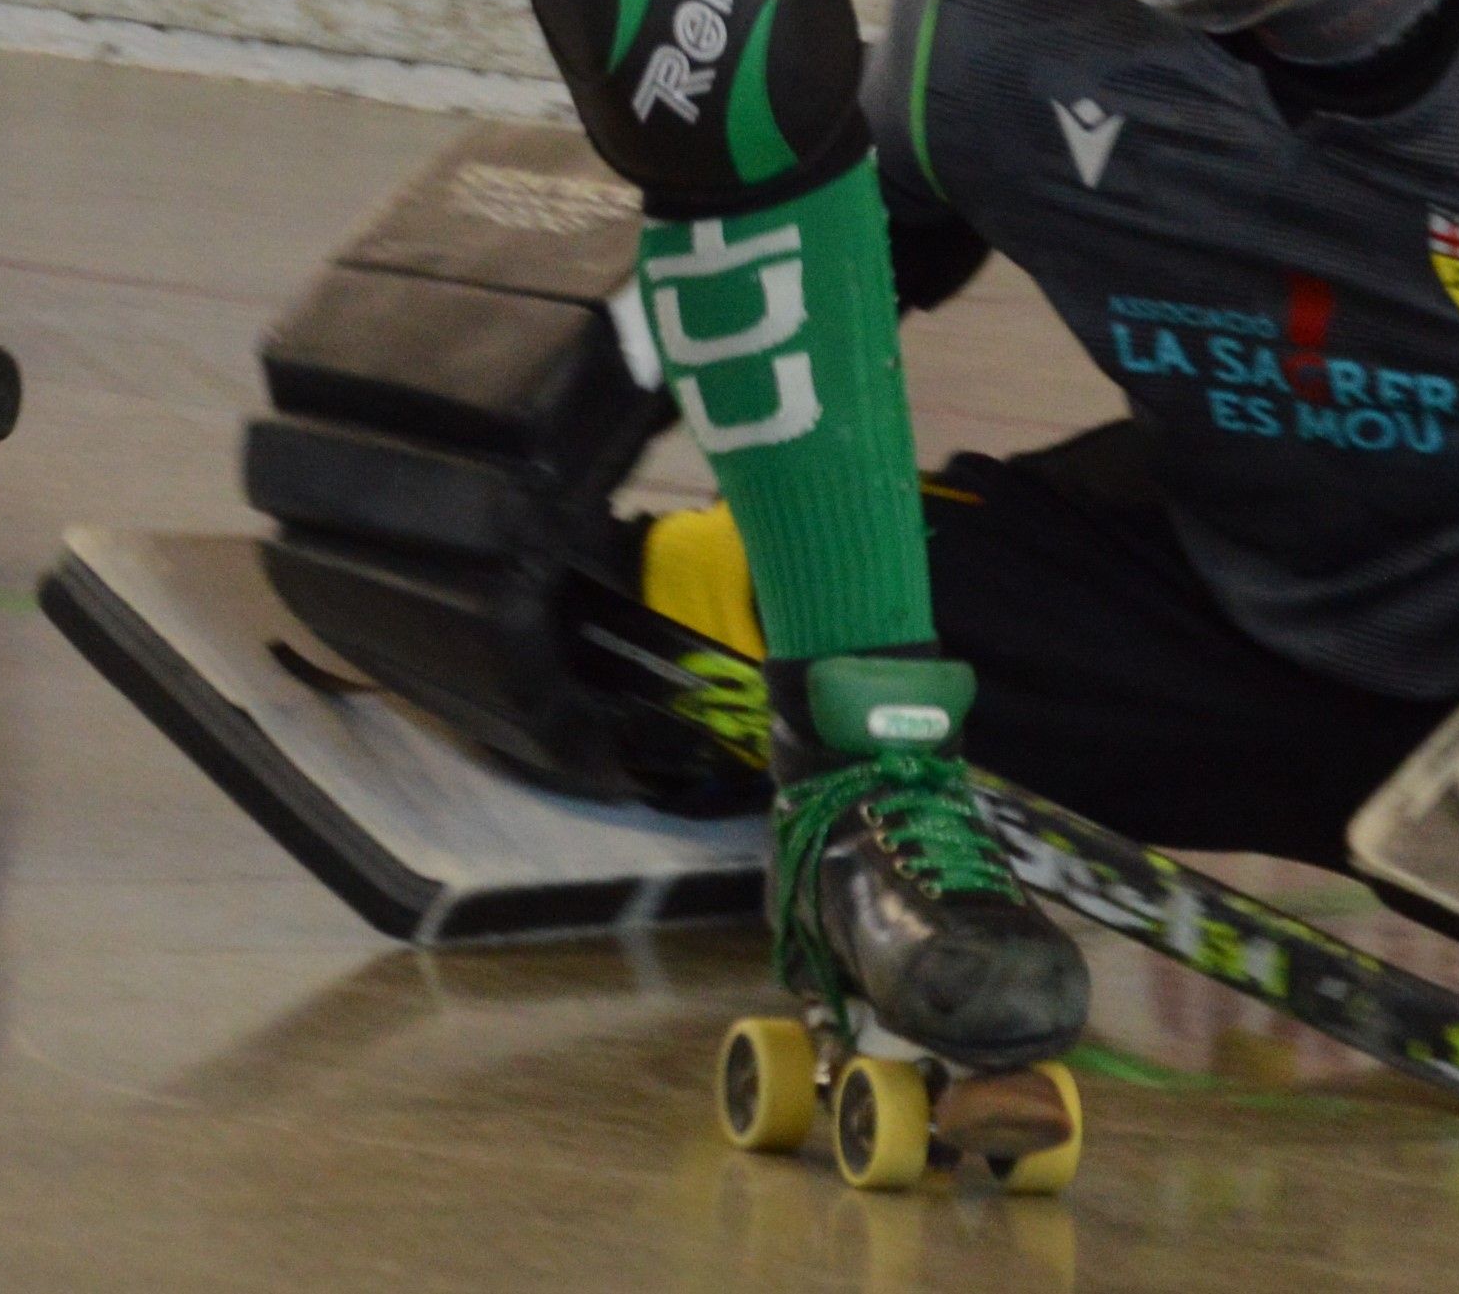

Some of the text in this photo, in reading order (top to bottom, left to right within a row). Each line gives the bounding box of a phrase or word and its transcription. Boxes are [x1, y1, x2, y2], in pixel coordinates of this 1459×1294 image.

[1110, 322, 1198, 377] LA
[1205, 387, 1445, 455] ES MOU
